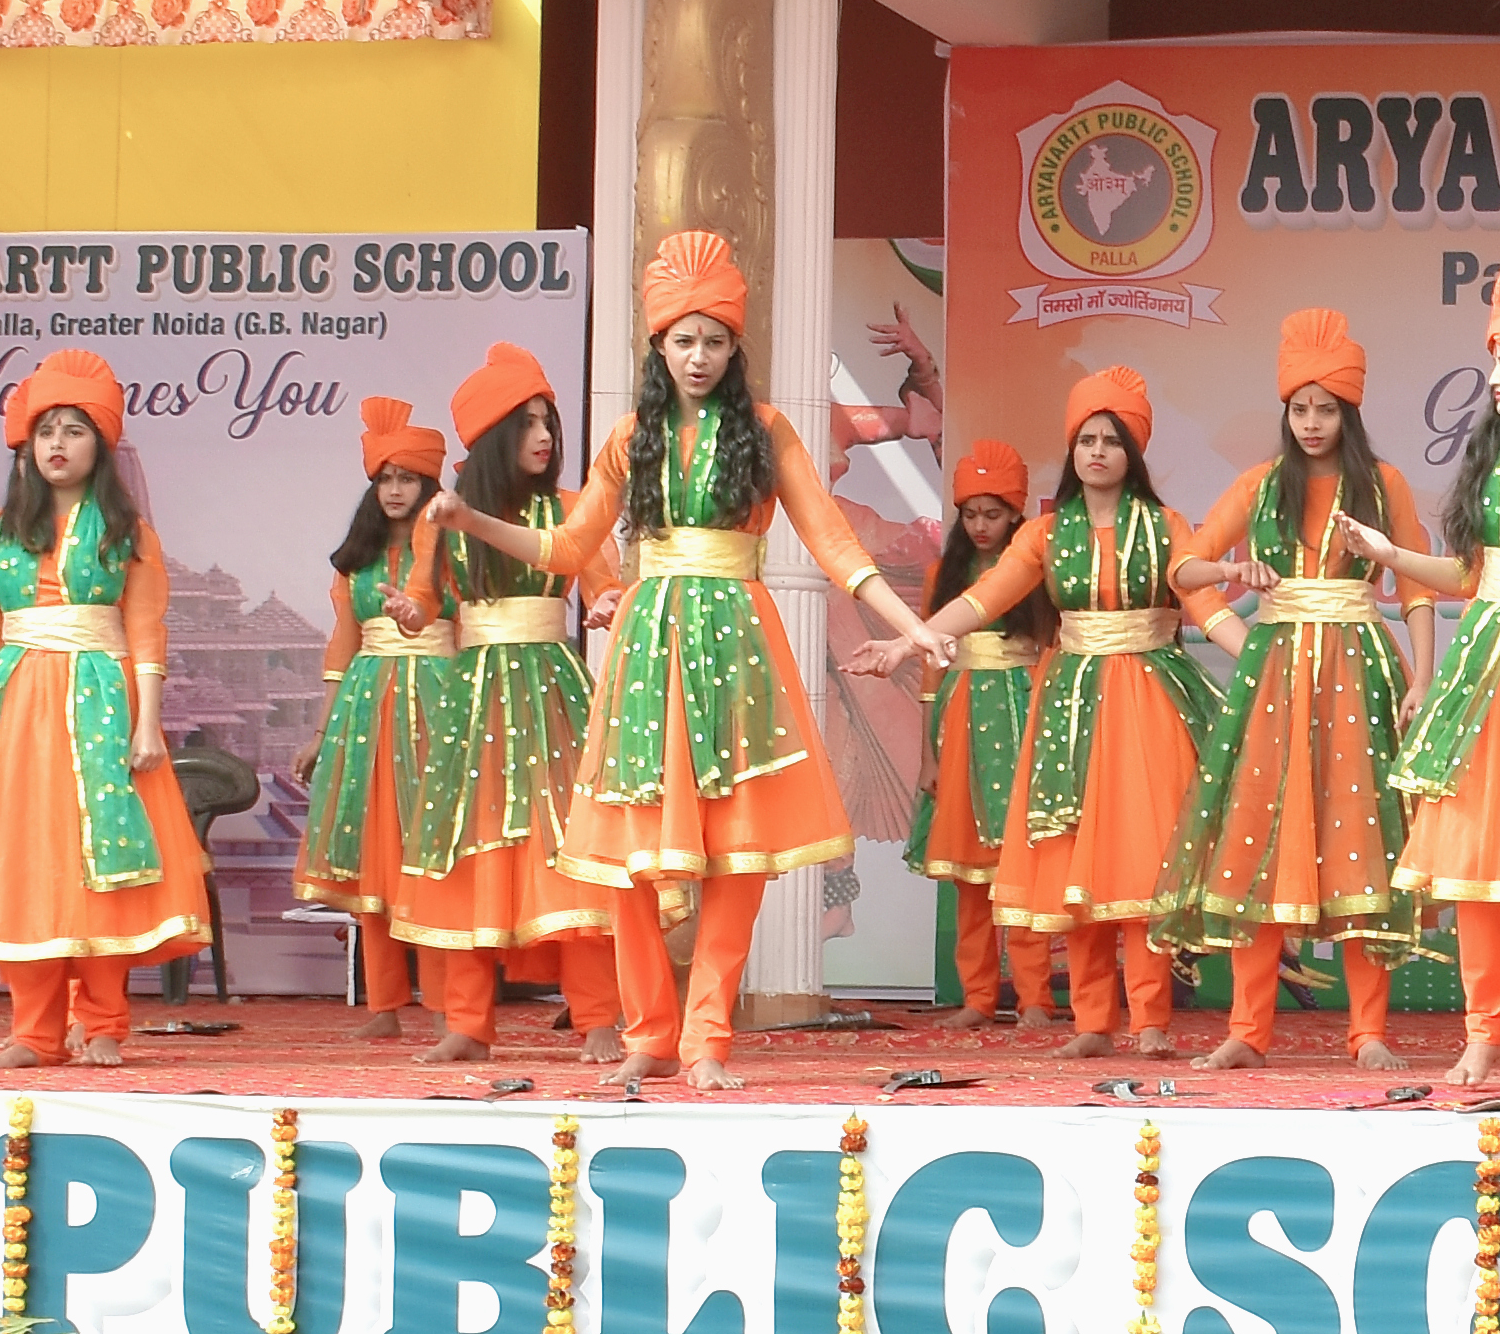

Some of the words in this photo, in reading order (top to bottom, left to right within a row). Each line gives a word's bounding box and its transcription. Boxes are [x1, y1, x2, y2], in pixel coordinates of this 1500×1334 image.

[1037, 119, 1091, 220] ARYAVARTT
[1098, 112, 1168, 144] PUBLIC
[1165, 142, 1194, 219] SCHOOL
[136, 244, 332, 295] PUBLIC
[353, 241, 571, 294] SCHOOL
[1090, 251, 1138, 267] PALLA
[1043, 292, 1084, 314] तमसो
[50, 312, 145, 337] Greater
[152, 311, 225, 337] Noida
[235, 310, 292, 340] (G.B.
[301, 310, 389, 341] Nagar)
[197, 348, 350, 440] You
